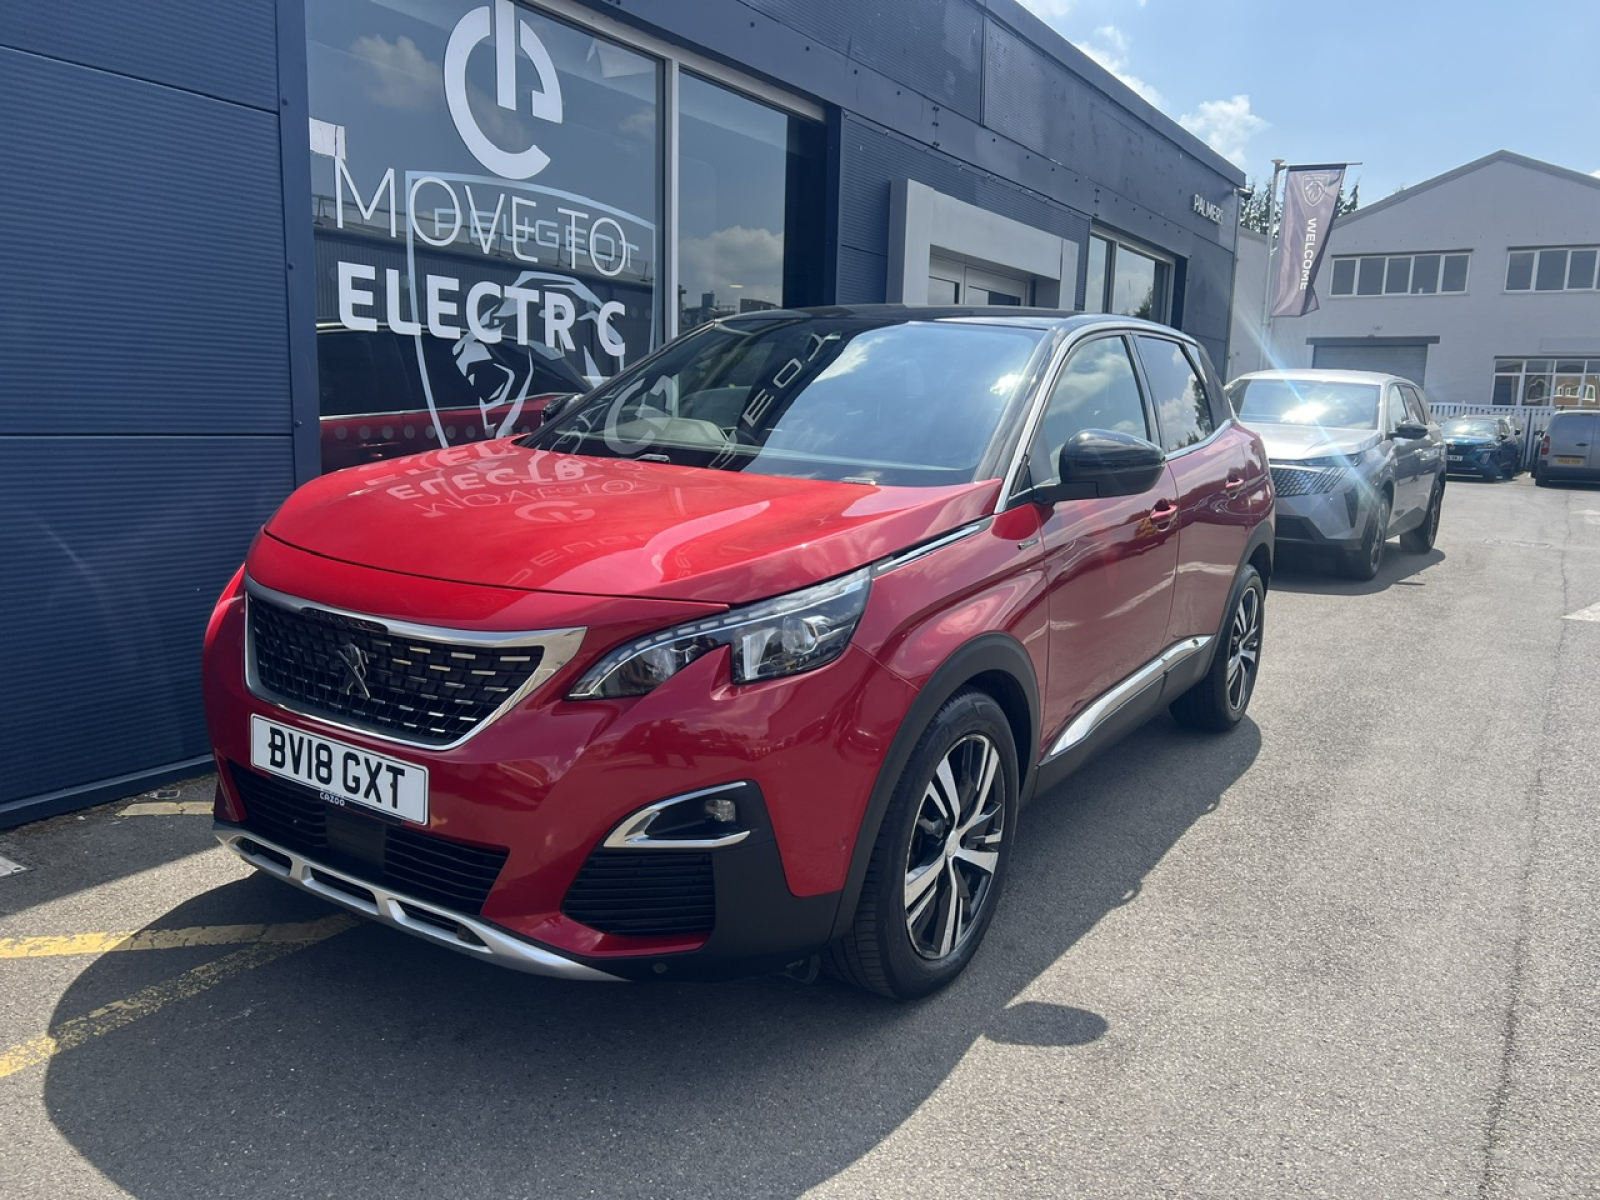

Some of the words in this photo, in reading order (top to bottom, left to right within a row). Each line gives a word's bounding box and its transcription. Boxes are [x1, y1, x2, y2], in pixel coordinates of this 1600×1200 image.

[334, 156, 538, 263] MOVE
[556, 206, 628, 276] TO
[434, 207, 639, 268] PEUGEOT
[1193, 194, 1224, 226] PALMERS
[1299, 217, 1317, 291] WELCOME
[338, 261, 626, 356] ELECTRC
[268, 726, 333, 785] BV18
[342, 751, 406, 809] GXT
